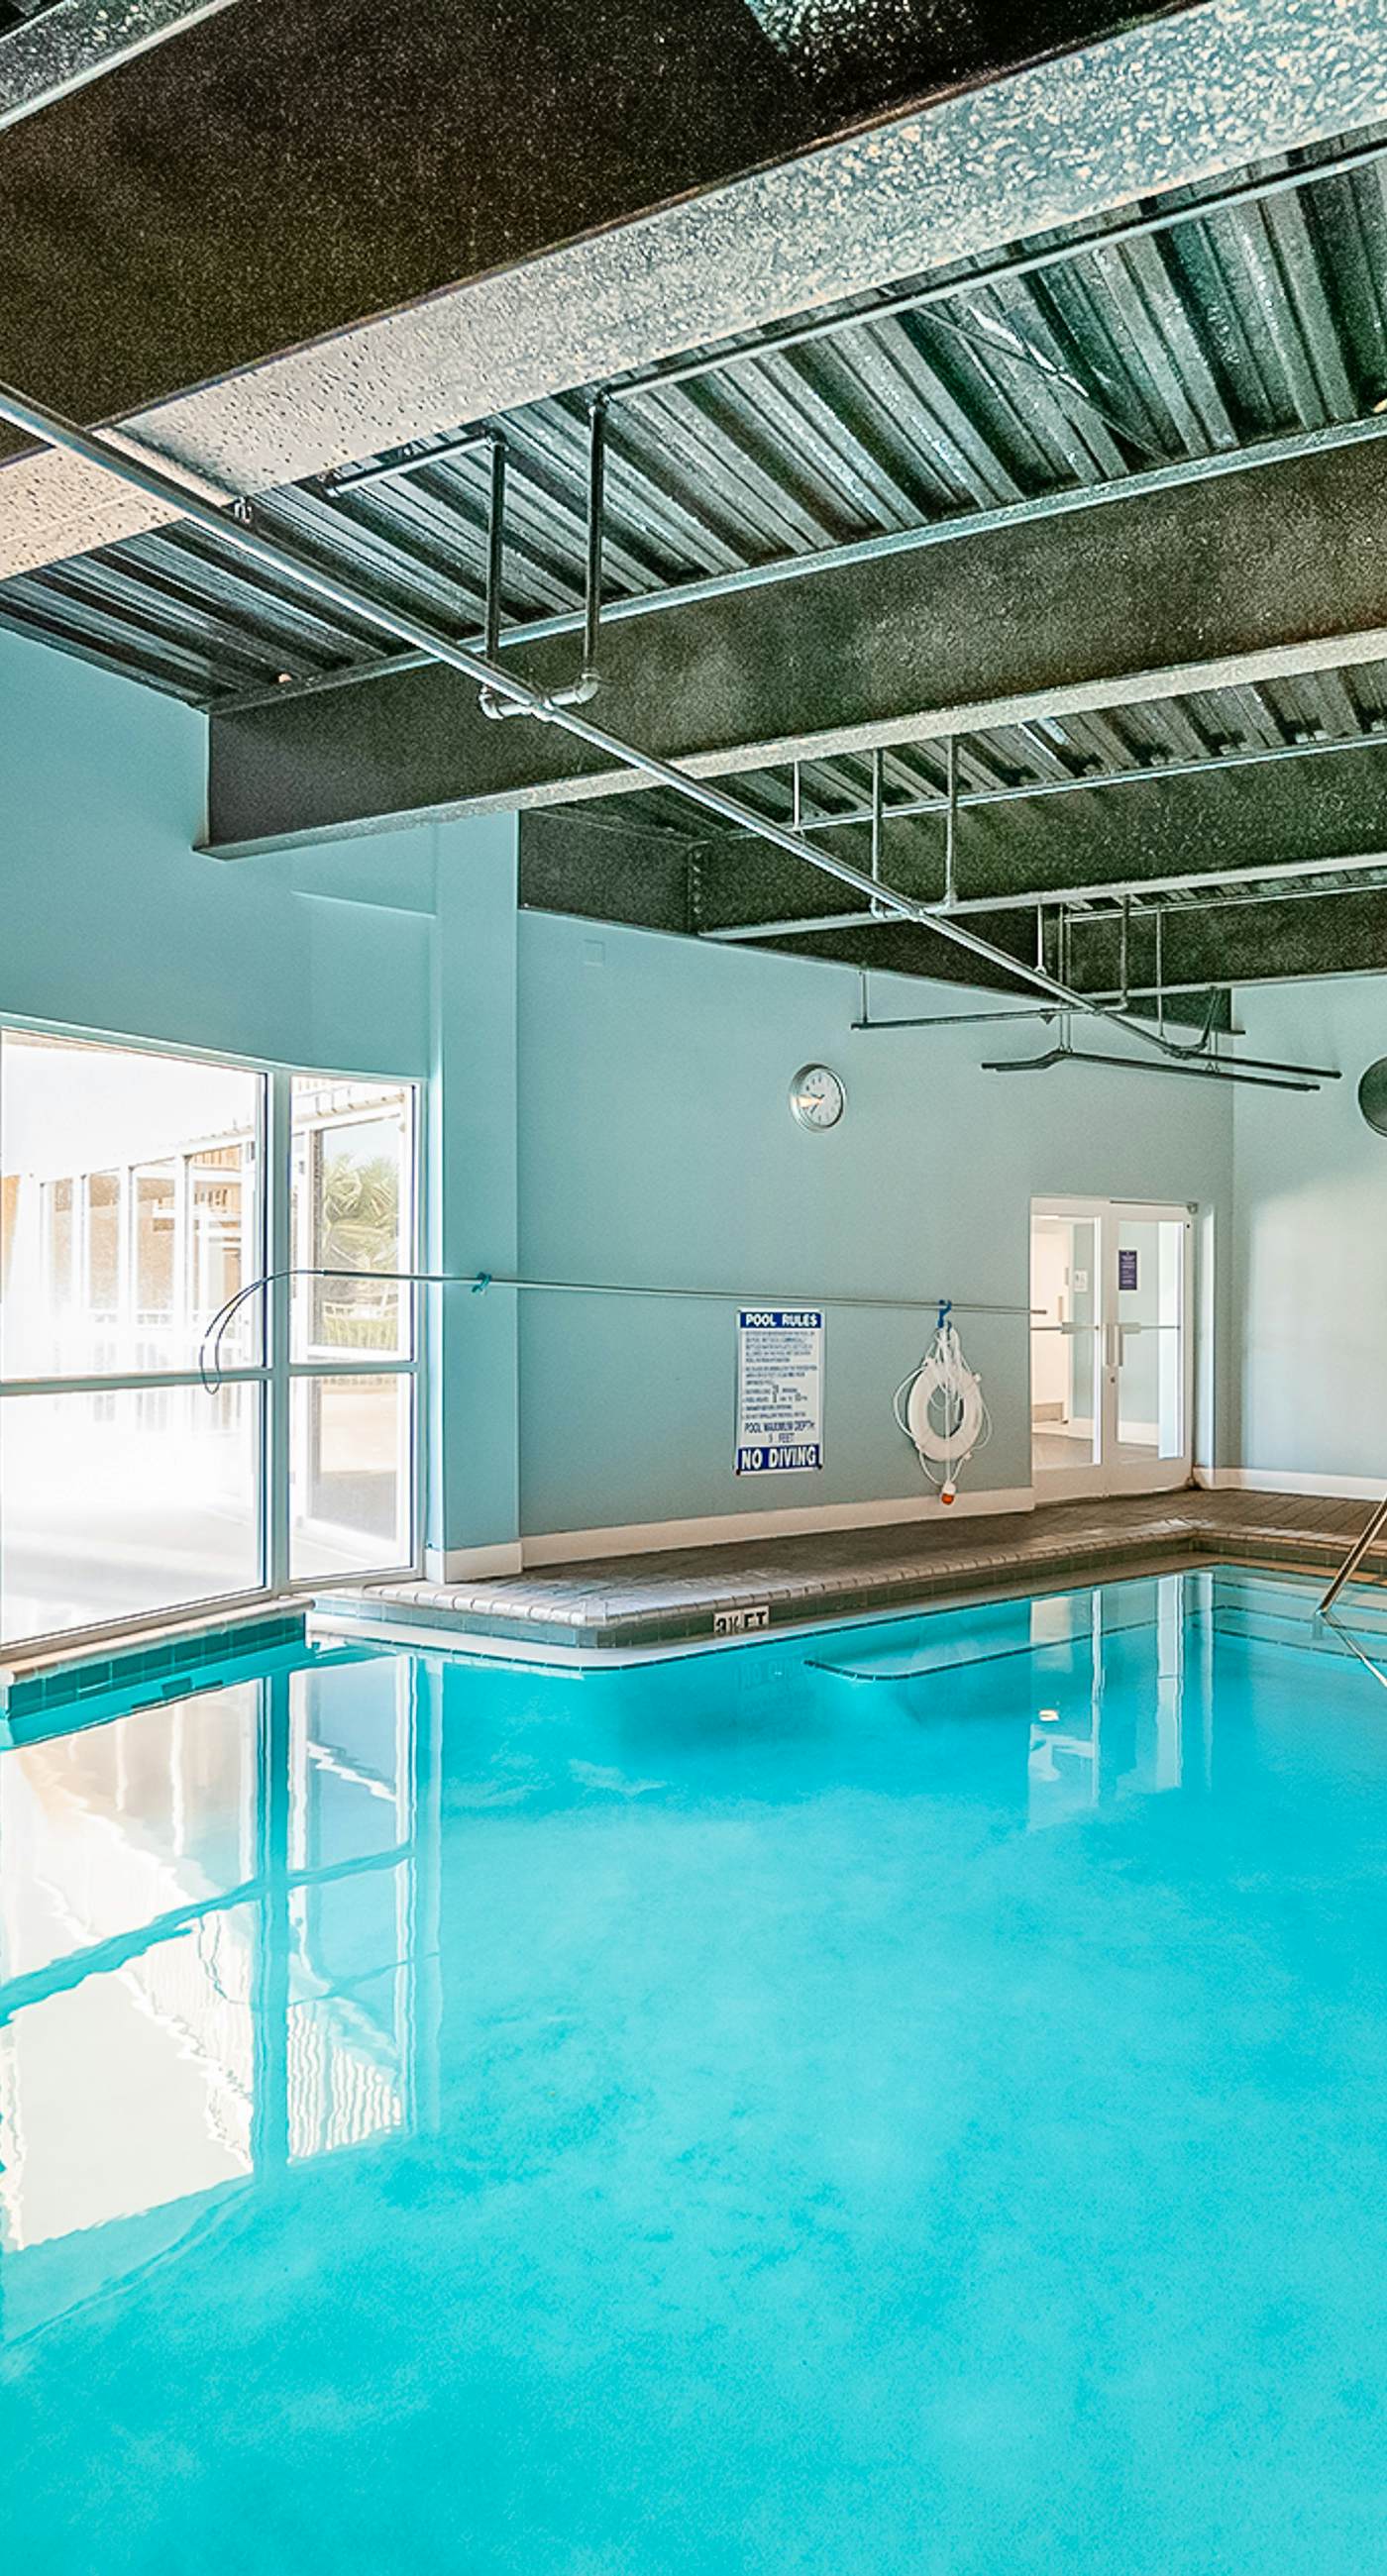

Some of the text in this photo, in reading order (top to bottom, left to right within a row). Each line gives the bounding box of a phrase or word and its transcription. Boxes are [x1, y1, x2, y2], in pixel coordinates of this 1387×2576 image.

[745, 1313, 818, 1327] POOL RULES
[744, 1422, 762, 1434] POOL
[741, 1446, 816, 1470] NO DIVING
